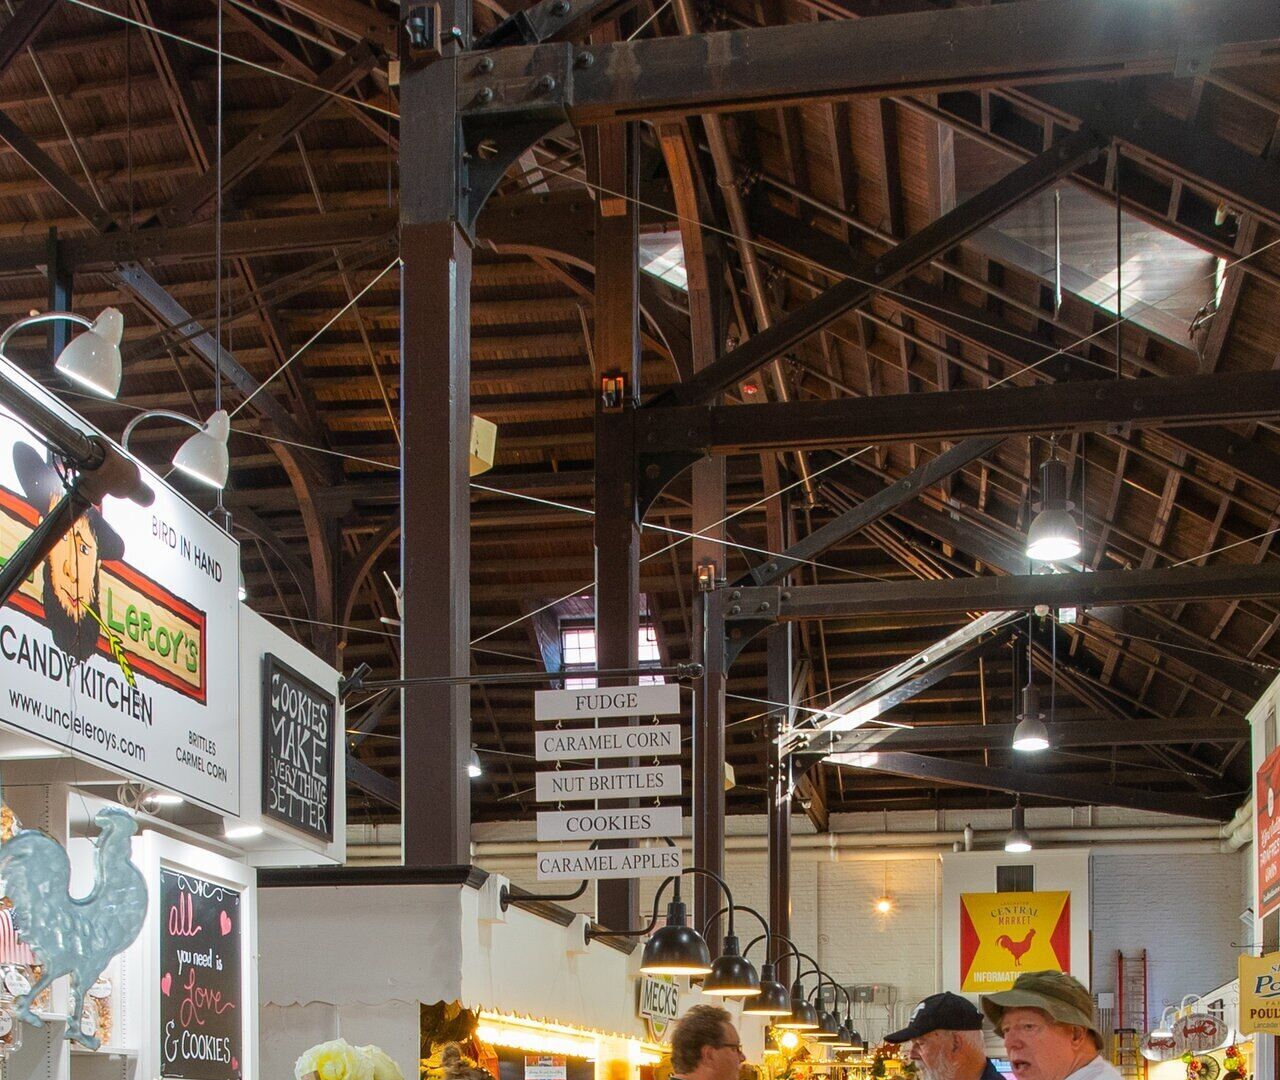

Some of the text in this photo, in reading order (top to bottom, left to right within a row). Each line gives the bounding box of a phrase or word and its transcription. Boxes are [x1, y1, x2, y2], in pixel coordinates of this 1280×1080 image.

[151, 514, 223, 583] BIRD IN HAND
[0, 625, 153, 726] CANDY KITCHEN
[272, 673, 327, 740] COOKIES
[576, 693, 638, 711] FUDGE
[9, 689, 146, 762] www.uncleleroys.com
[188, 730, 216, 757] BRITTLES
[544, 731, 672, 753] CARAMEL CORN
[176, 747, 228, 783] CARMEL CORN
[272, 713, 327, 786] MAKE
[270, 751, 328, 806] VERYTHING
[552, 773, 664, 793] NUT BRITTLES
[270, 776, 327, 834] BETTER
[566, 814, 651, 832] COOKIES
[540, 853, 680, 874] CARAMEL APPLES
[169, 891, 202, 936] all
[990, 906, 1039, 919] CENTRAL
[998, 916, 1031, 926] MARKET
[176, 948, 223, 975] you need is
[973, 971, 1026, 982] INFORMATI
[181, 968, 235, 1028] Love
[164, 1019, 231, 1064] & COOKIES
